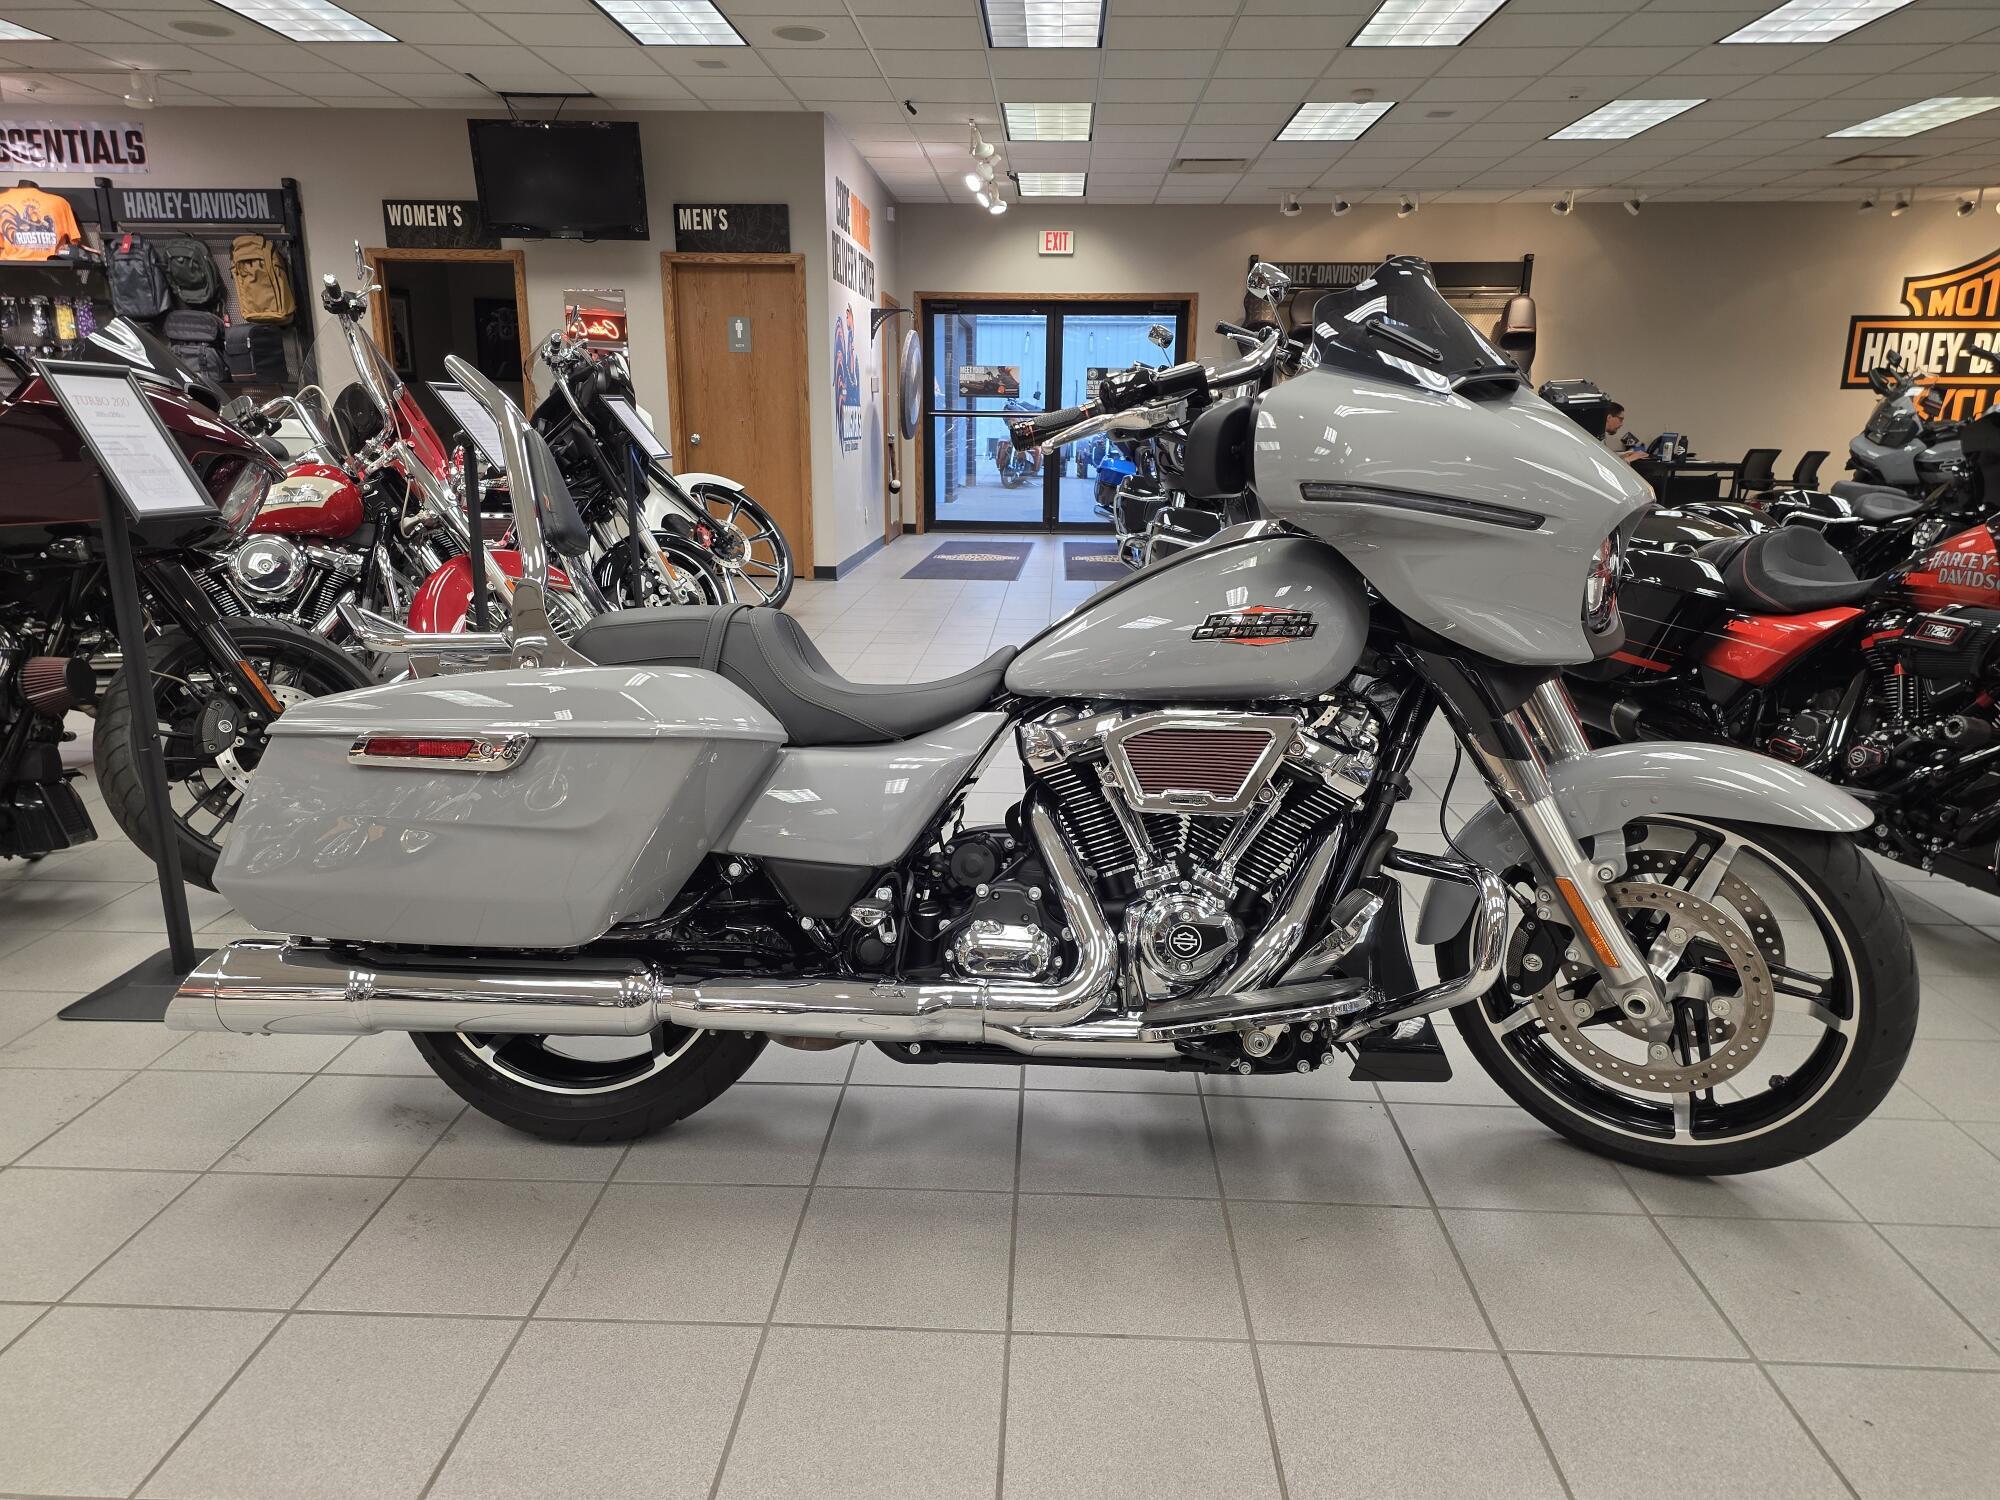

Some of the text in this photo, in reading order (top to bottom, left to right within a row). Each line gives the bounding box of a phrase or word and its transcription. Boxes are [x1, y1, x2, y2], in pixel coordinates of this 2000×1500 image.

[123, 191, 271, 219] HARLEY-DAVIDSON
[386, 204, 463, 227] WOMEN'S
[678, 208, 729, 231] MEN'S
[1045, 231, 1069, 251] EXIT
[1924, 623, 1956, 638] 121
